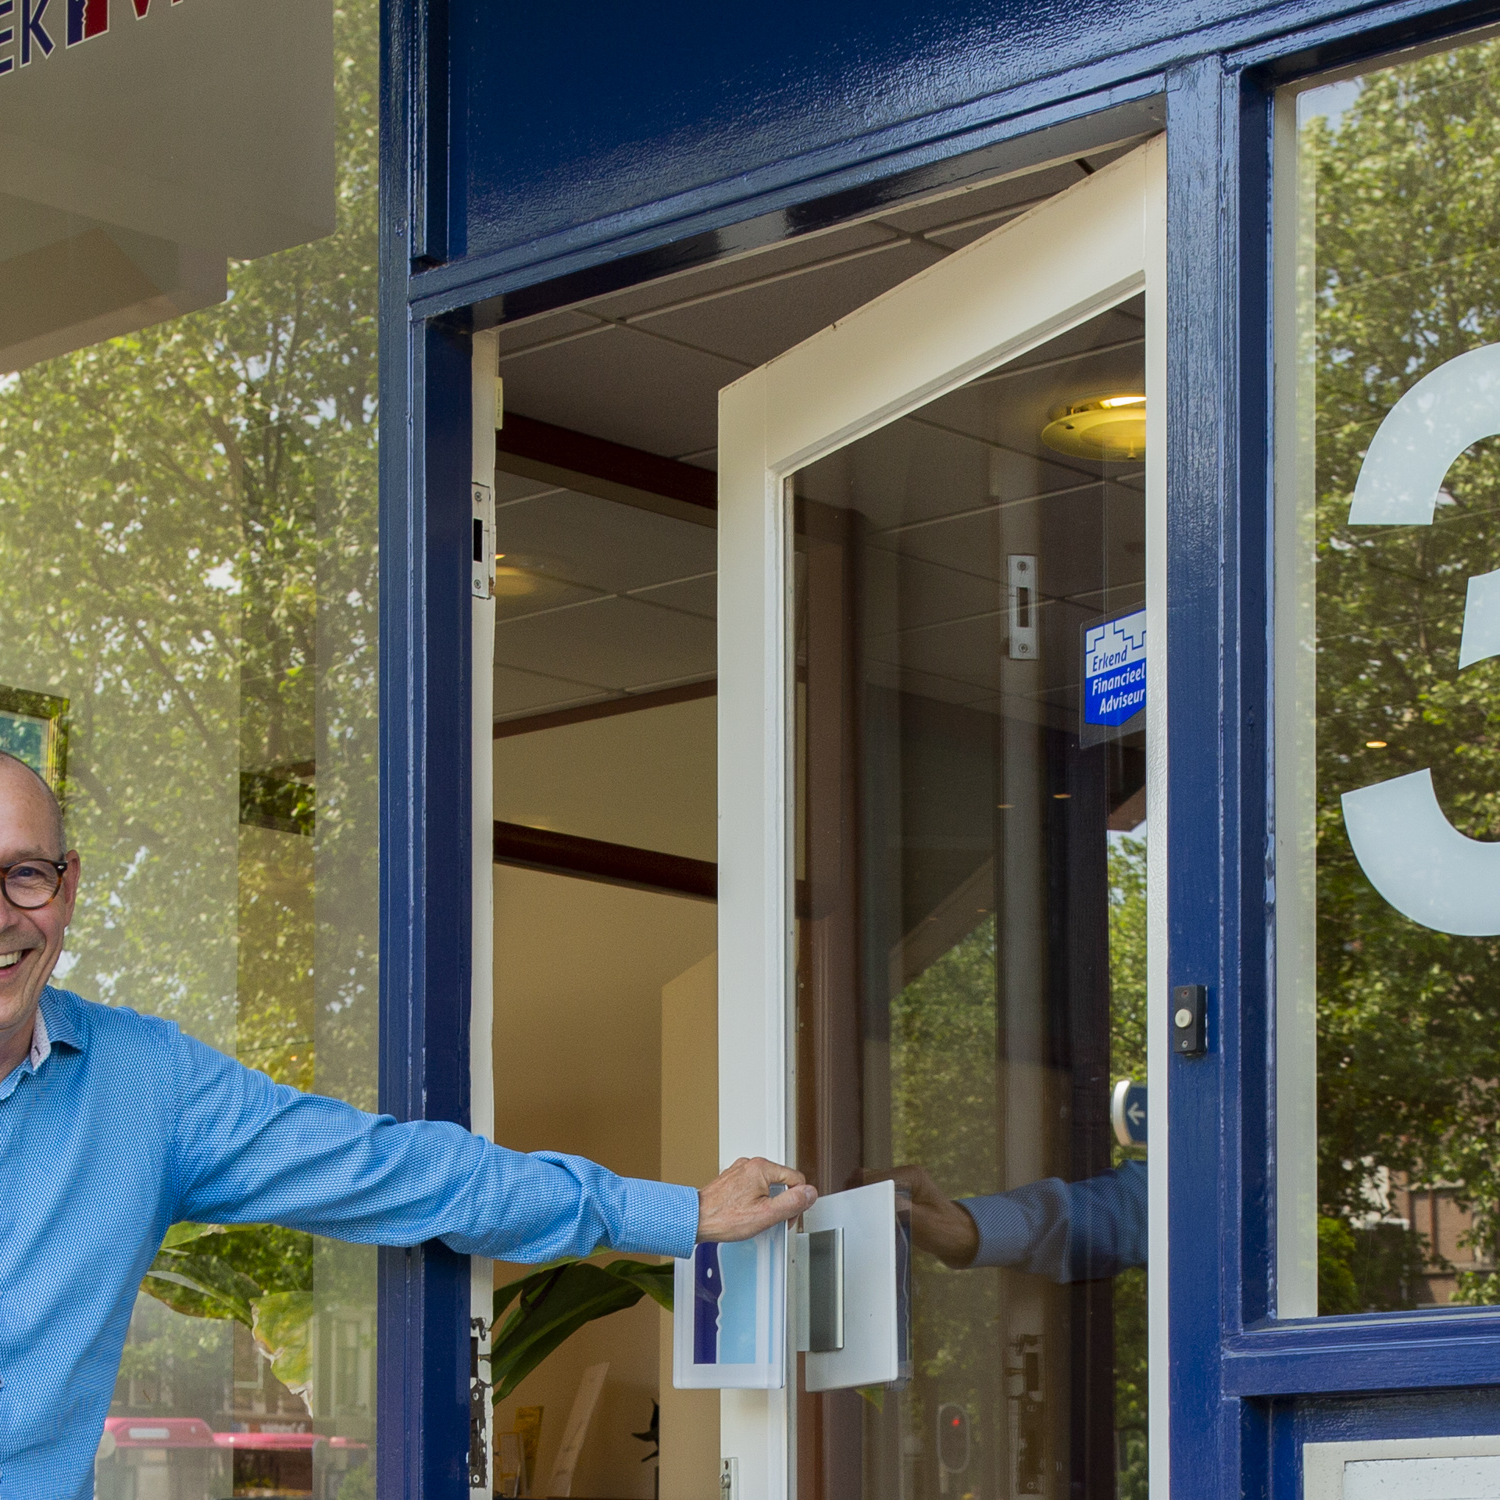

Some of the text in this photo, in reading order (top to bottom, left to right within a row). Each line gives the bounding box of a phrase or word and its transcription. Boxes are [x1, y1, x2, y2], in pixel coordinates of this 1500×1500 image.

[1092, 645, 1128, 672] Erkend
[1092, 662, 1146, 696] Financieel
[1099, 688, 1146, 715] Adviseur
